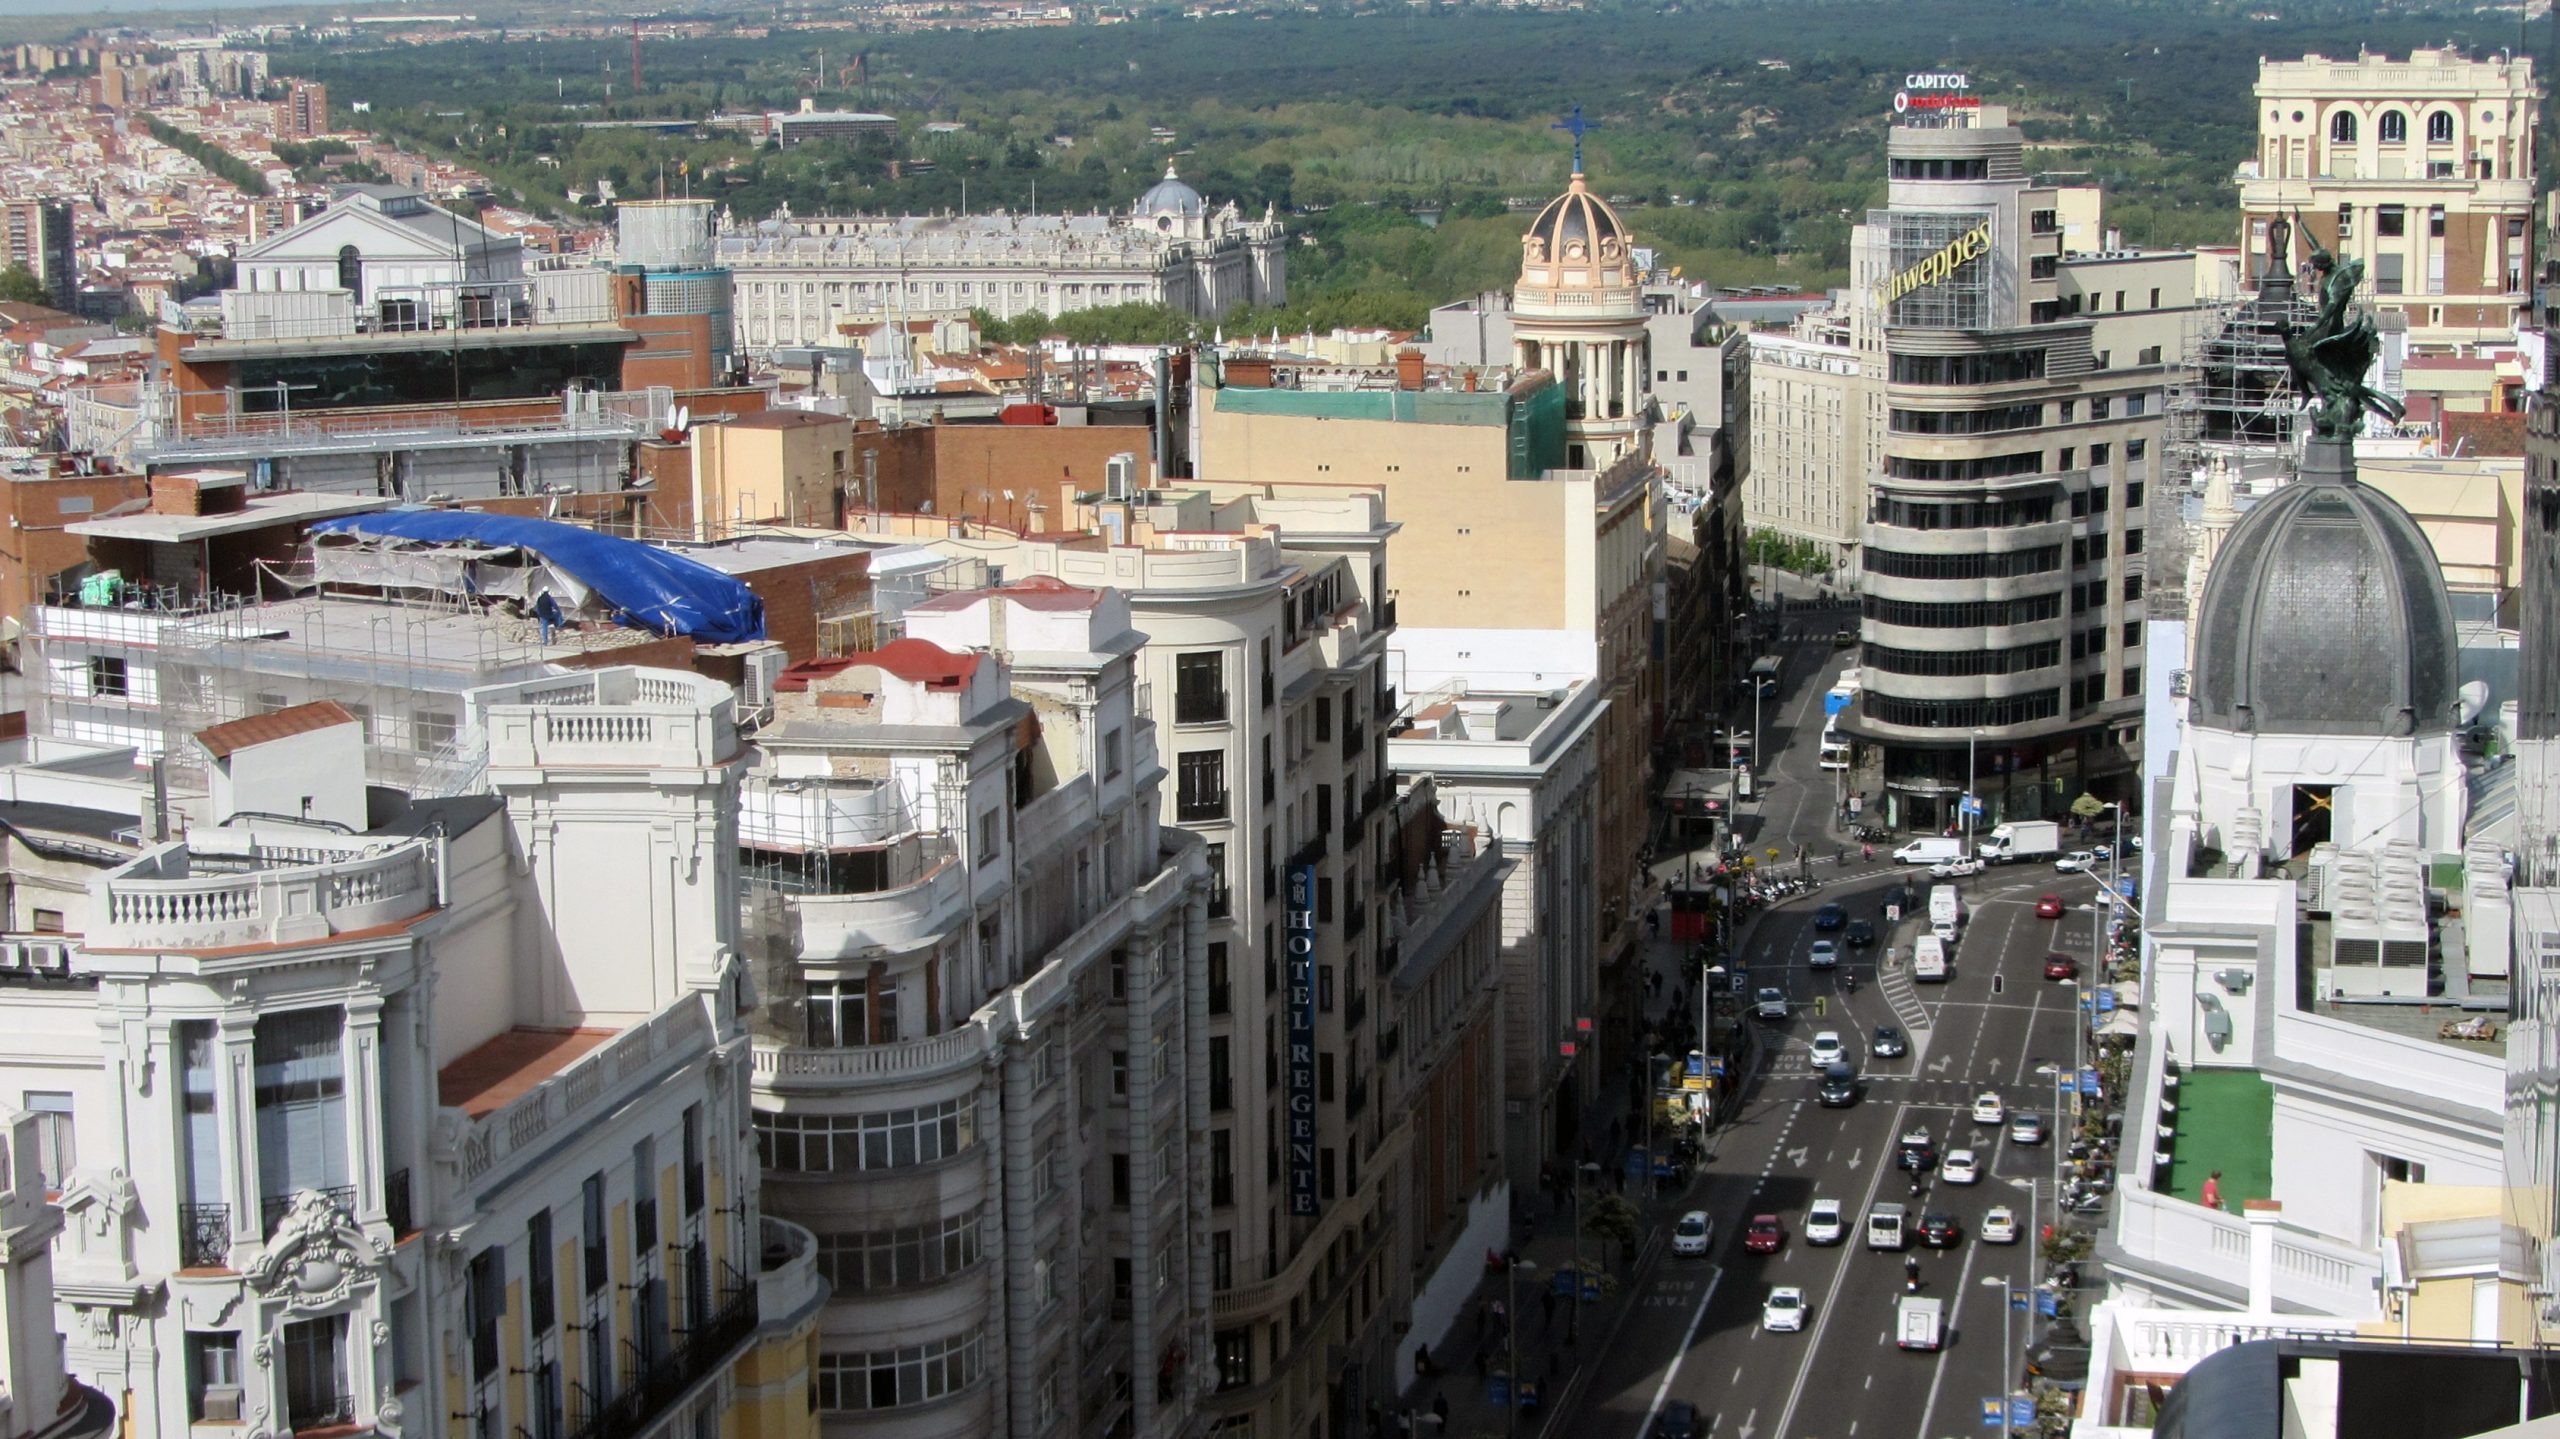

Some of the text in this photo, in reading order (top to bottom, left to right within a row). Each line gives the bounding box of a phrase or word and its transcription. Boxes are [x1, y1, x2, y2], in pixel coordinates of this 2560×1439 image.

[1905, 74, 1969, 89] CAPITOL
[1287, 910, 1312, 1030] HOTEL
[1290, 1044, 1313, 1213] REGENTE
